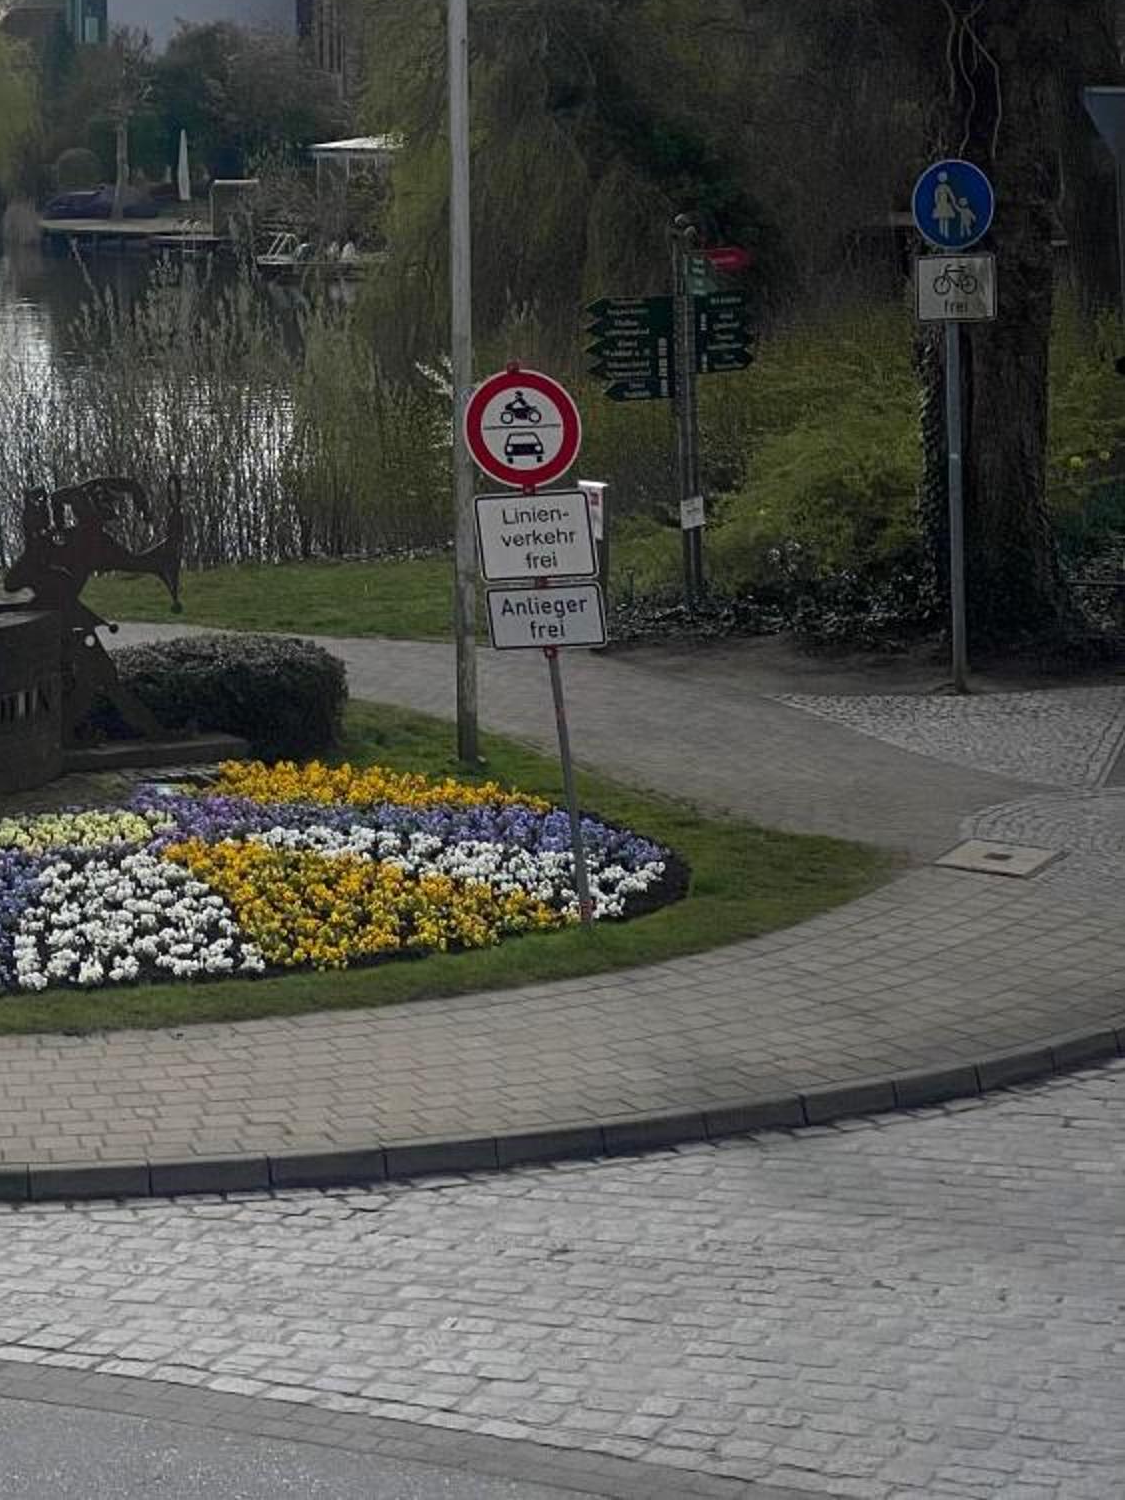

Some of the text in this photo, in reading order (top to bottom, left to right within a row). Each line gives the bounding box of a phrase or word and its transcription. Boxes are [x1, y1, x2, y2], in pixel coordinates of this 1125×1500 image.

[943, 299, 968, 316] frei
[501, 506, 570, 525] Linien-
[500, 528, 576, 547] verkehr
[525, 551, 558, 569] frei
[500, 596, 588, 619] Anlieger
[530, 619, 566, 640] frei
